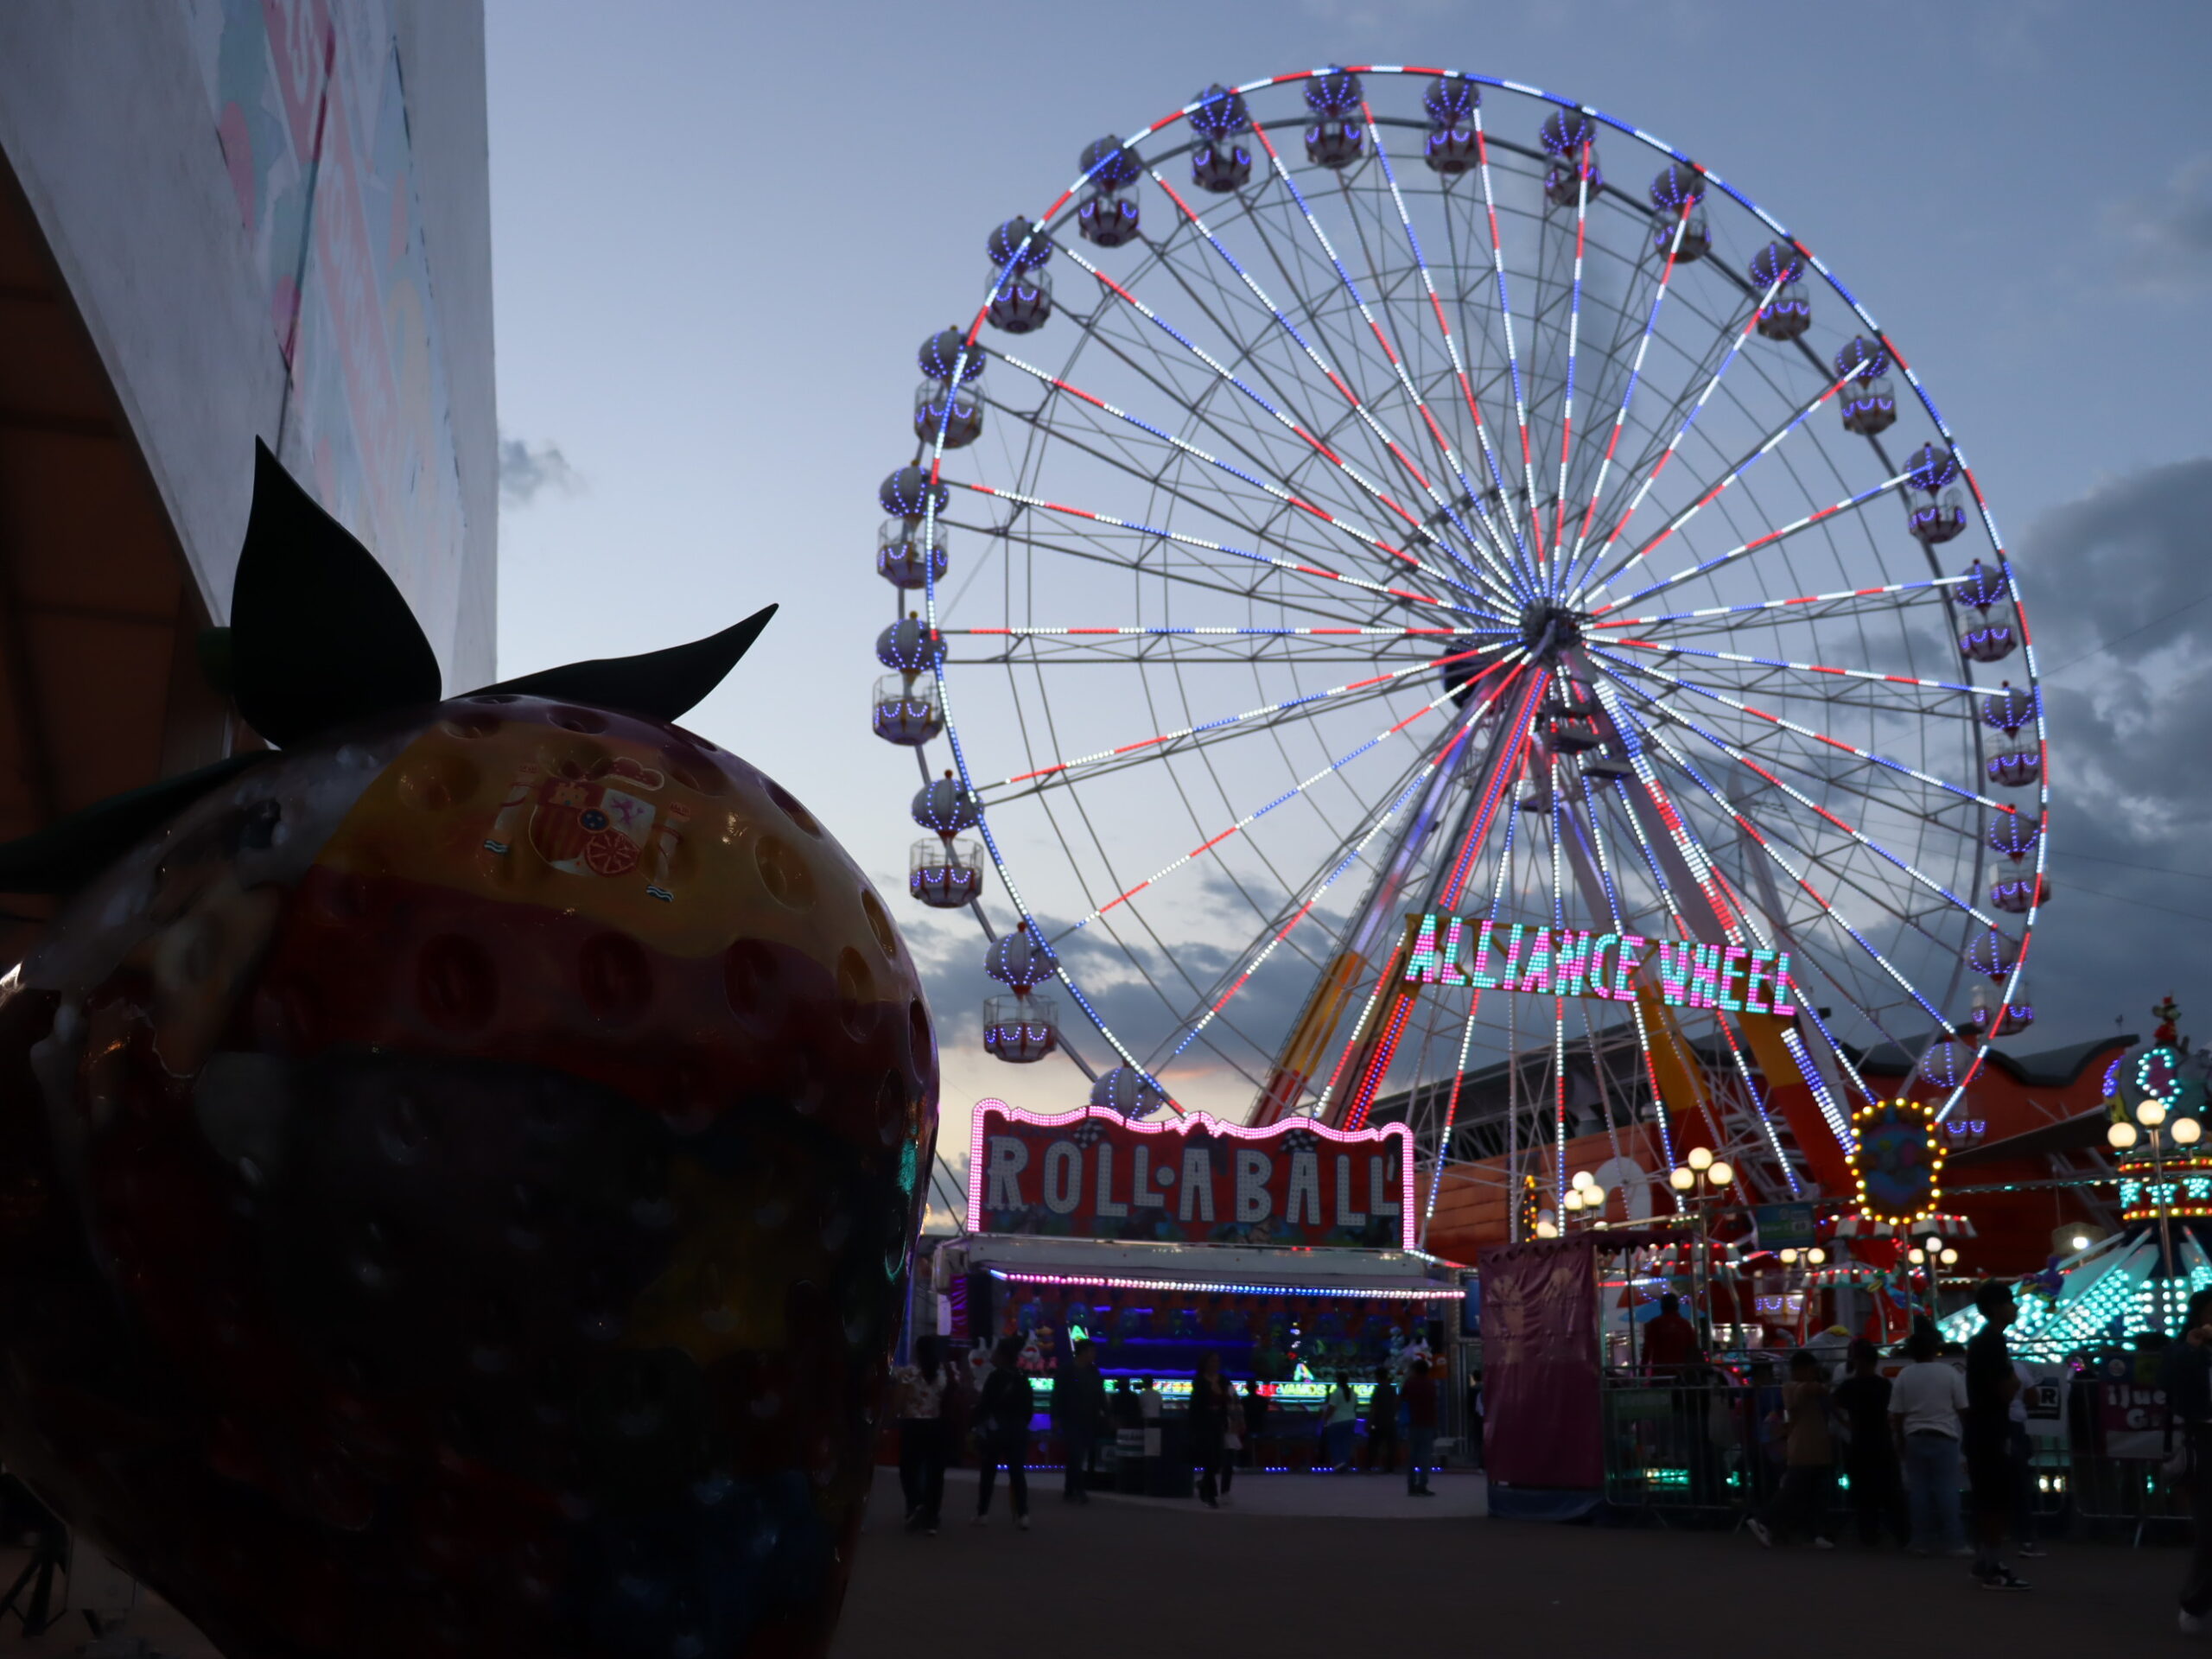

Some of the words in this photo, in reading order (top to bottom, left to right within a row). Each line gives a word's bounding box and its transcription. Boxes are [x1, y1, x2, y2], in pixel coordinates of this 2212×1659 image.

[1404, 912, 1646, 1002] ALLIANCE
[1658, 938, 1796, 1016] WHEEL
[1234, 1148, 1400, 1227] BALL
